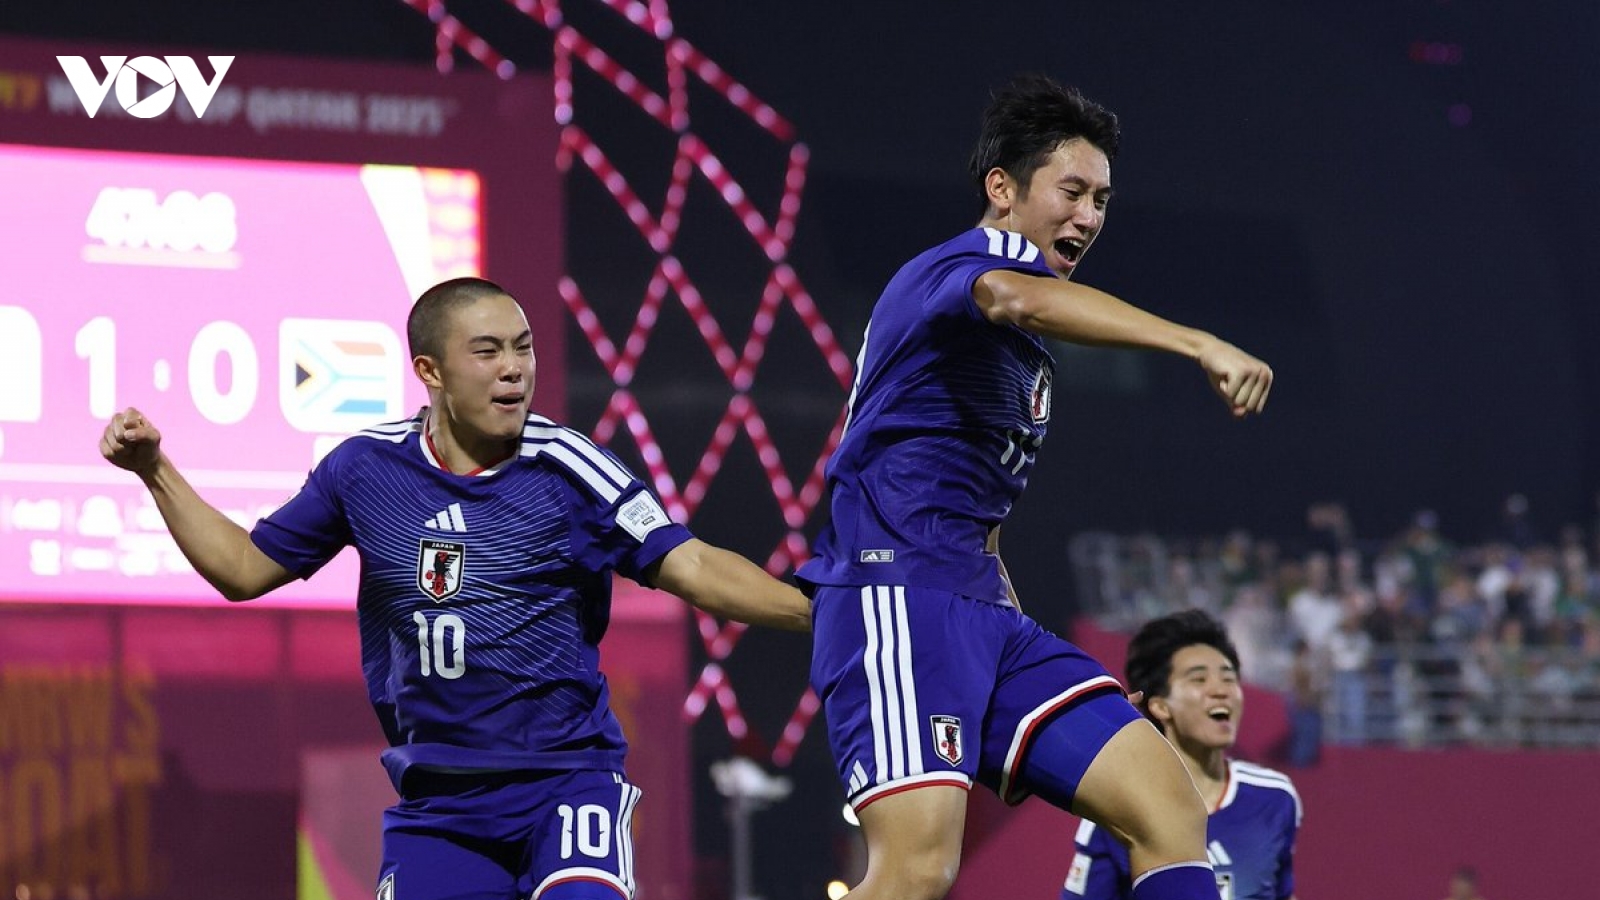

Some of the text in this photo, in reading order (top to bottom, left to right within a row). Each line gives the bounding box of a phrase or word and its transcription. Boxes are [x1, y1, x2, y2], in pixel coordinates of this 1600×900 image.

[75, 316, 258, 424] 1 0
[431, 542, 454, 551] JAPAN
[413, 610, 466, 679] 10
[557, 803, 611, 860] 10
